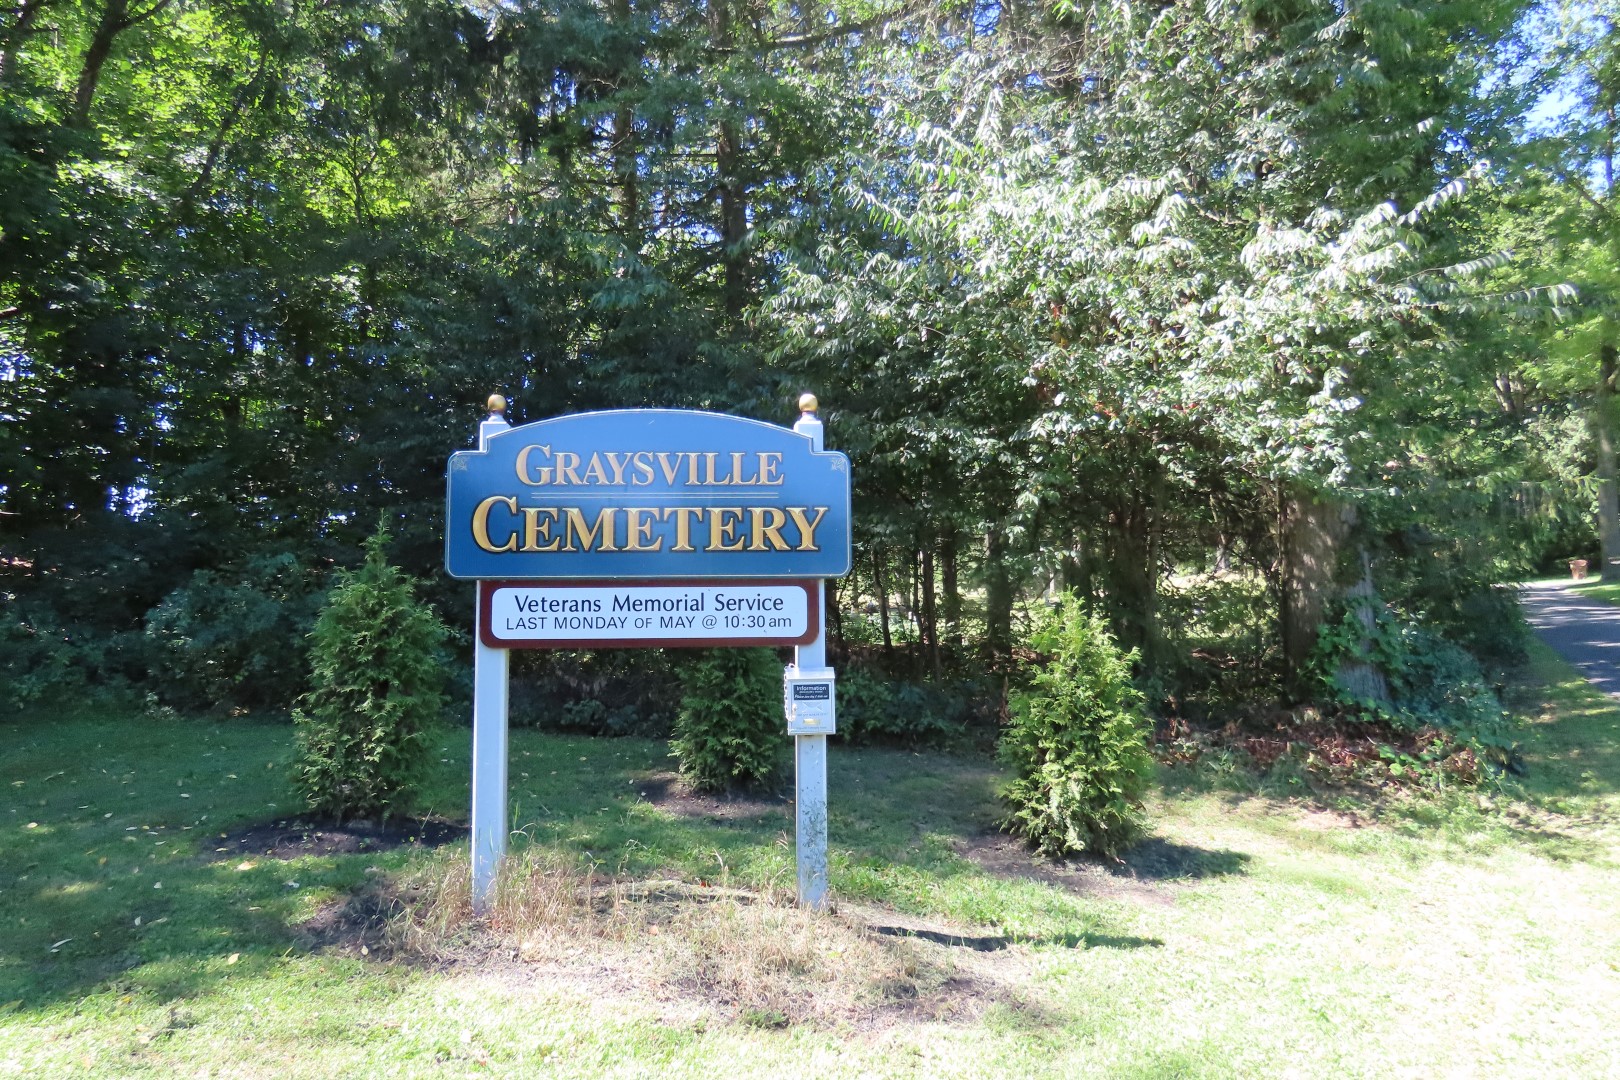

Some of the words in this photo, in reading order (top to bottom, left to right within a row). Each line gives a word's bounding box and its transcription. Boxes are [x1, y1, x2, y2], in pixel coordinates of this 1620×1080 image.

[515, 444, 784, 486] GRAYSVILLE
[471, 495, 828, 553] CEMETERY
[514, 595, 602, 613] Veterans
[612, 594, 705, 613] Memorial
[714, 593, 784, 611] Service
[506, 616, 547, 631] LAST
[553, 616, 627, 630] MONDAY
[634, 616, 653, 630] OF
[659, 615, 696, 629] MAY
[701, 614, 717, 630] @
